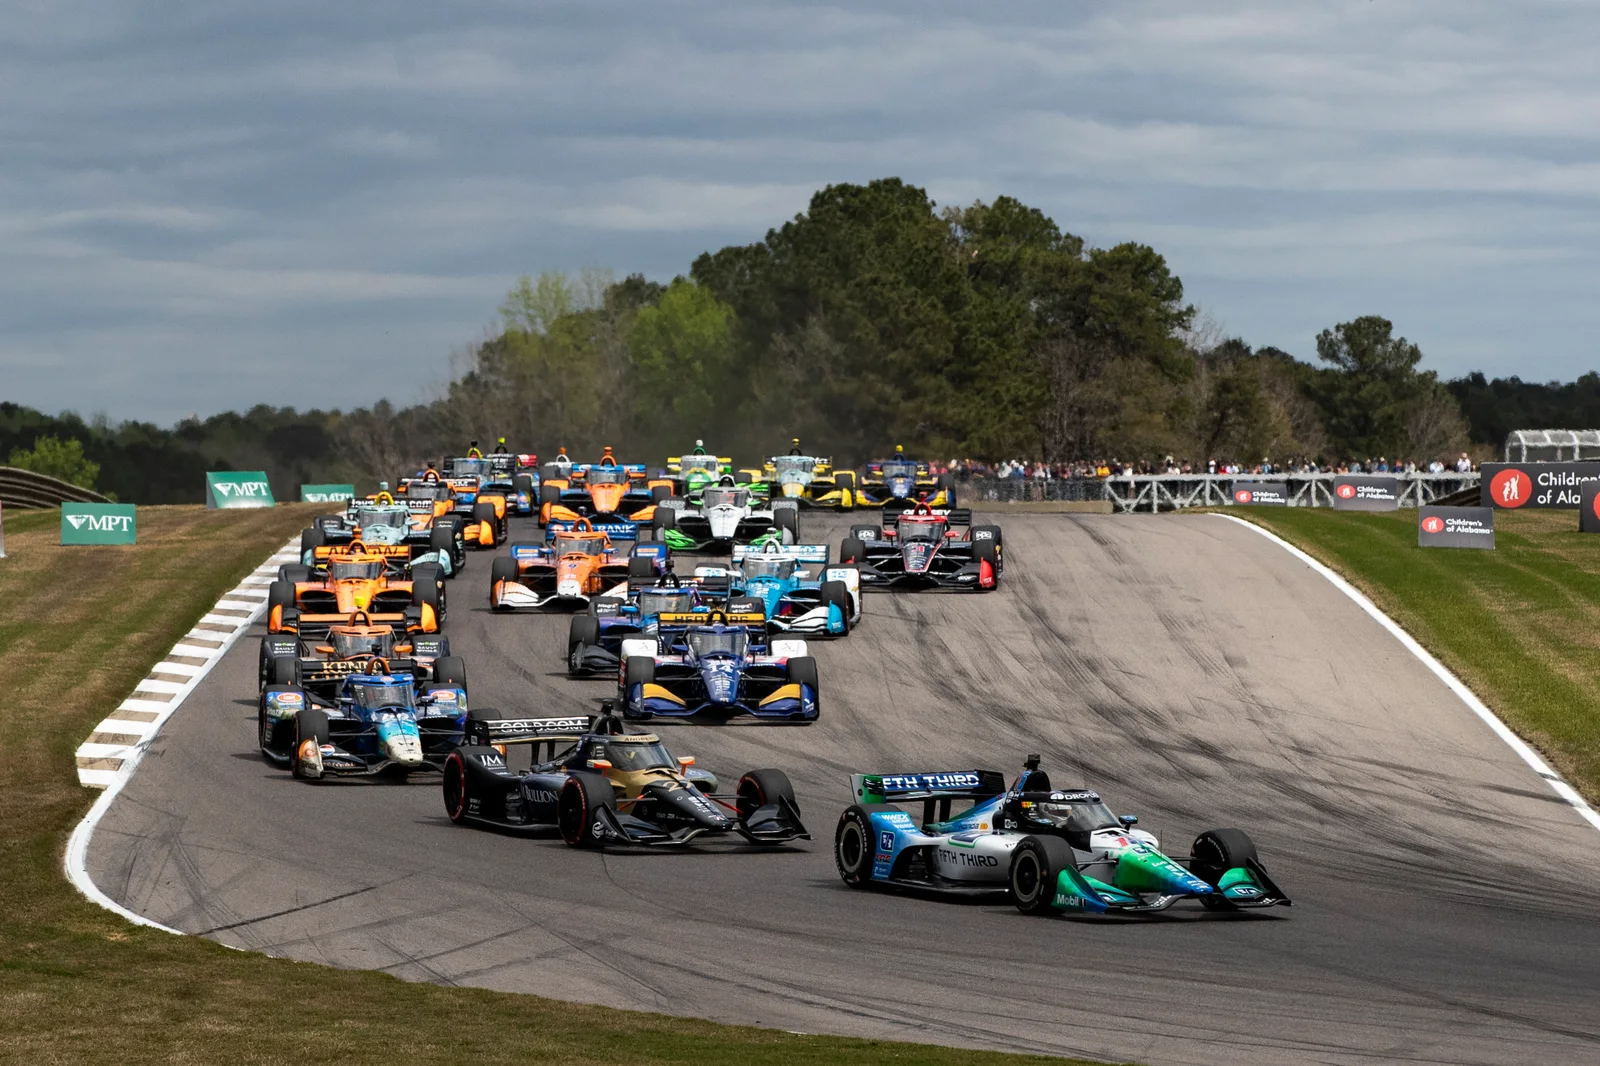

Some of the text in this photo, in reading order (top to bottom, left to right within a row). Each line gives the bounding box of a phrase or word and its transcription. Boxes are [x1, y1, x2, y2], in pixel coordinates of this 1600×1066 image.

[234, 482, 268, 496] MPT
[1366, 492, 1395, 500] Alabama
[1538, 490, 1552, 504] of
[88, 515, 132, 532] MPT
[596, 525, 635, 534] BANK
[1445, 518, 1483, 527] Children's
[1456, 526, 1491, 534] Alabama
[500, 720, 584, 733] GOLD.COM
[923, 774, 980, 788] THIRD
[959, 852, 999, 868] THIRD
[1056, 893, 1080, 907] Mobil
